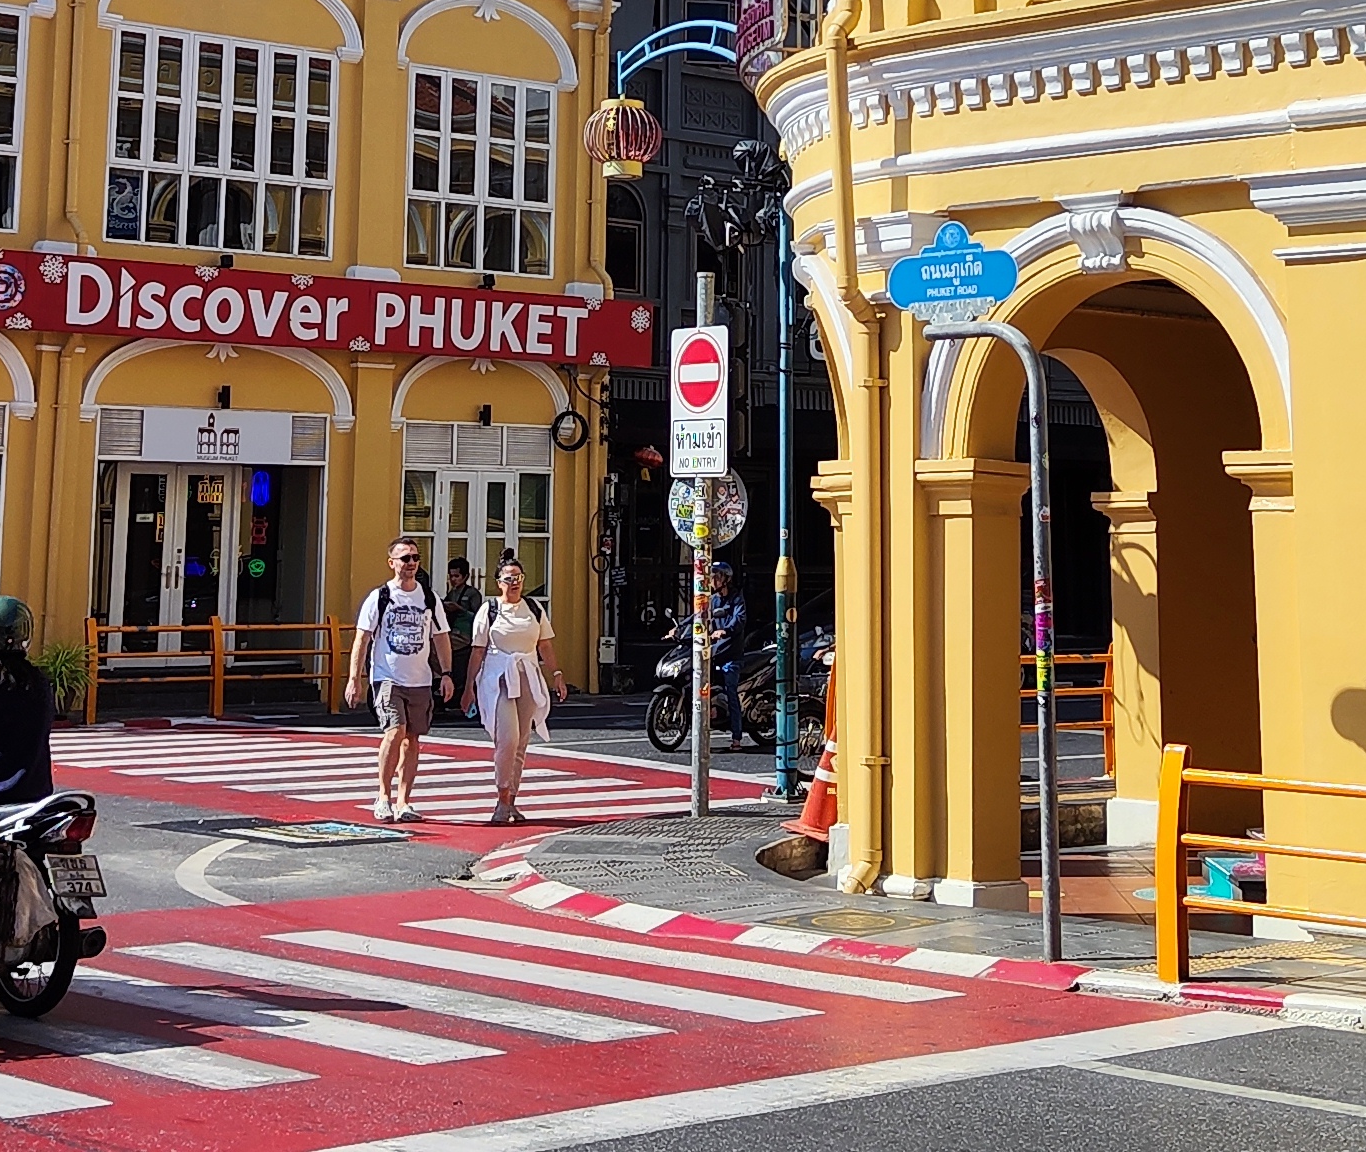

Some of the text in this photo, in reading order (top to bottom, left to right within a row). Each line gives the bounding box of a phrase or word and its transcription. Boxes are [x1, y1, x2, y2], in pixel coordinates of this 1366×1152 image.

[921, 254, 982, 285] ถนนภูเก็ต
[926, 285, 978, 298] PHUKET ROAD
[65, 261, 589, 357] Discover PHUKET
[676, 422, 722, 450] ห้ามเข้า
[679, 457, 717, 468] NO ENTRY
[67, 881, 93, 893] 374
